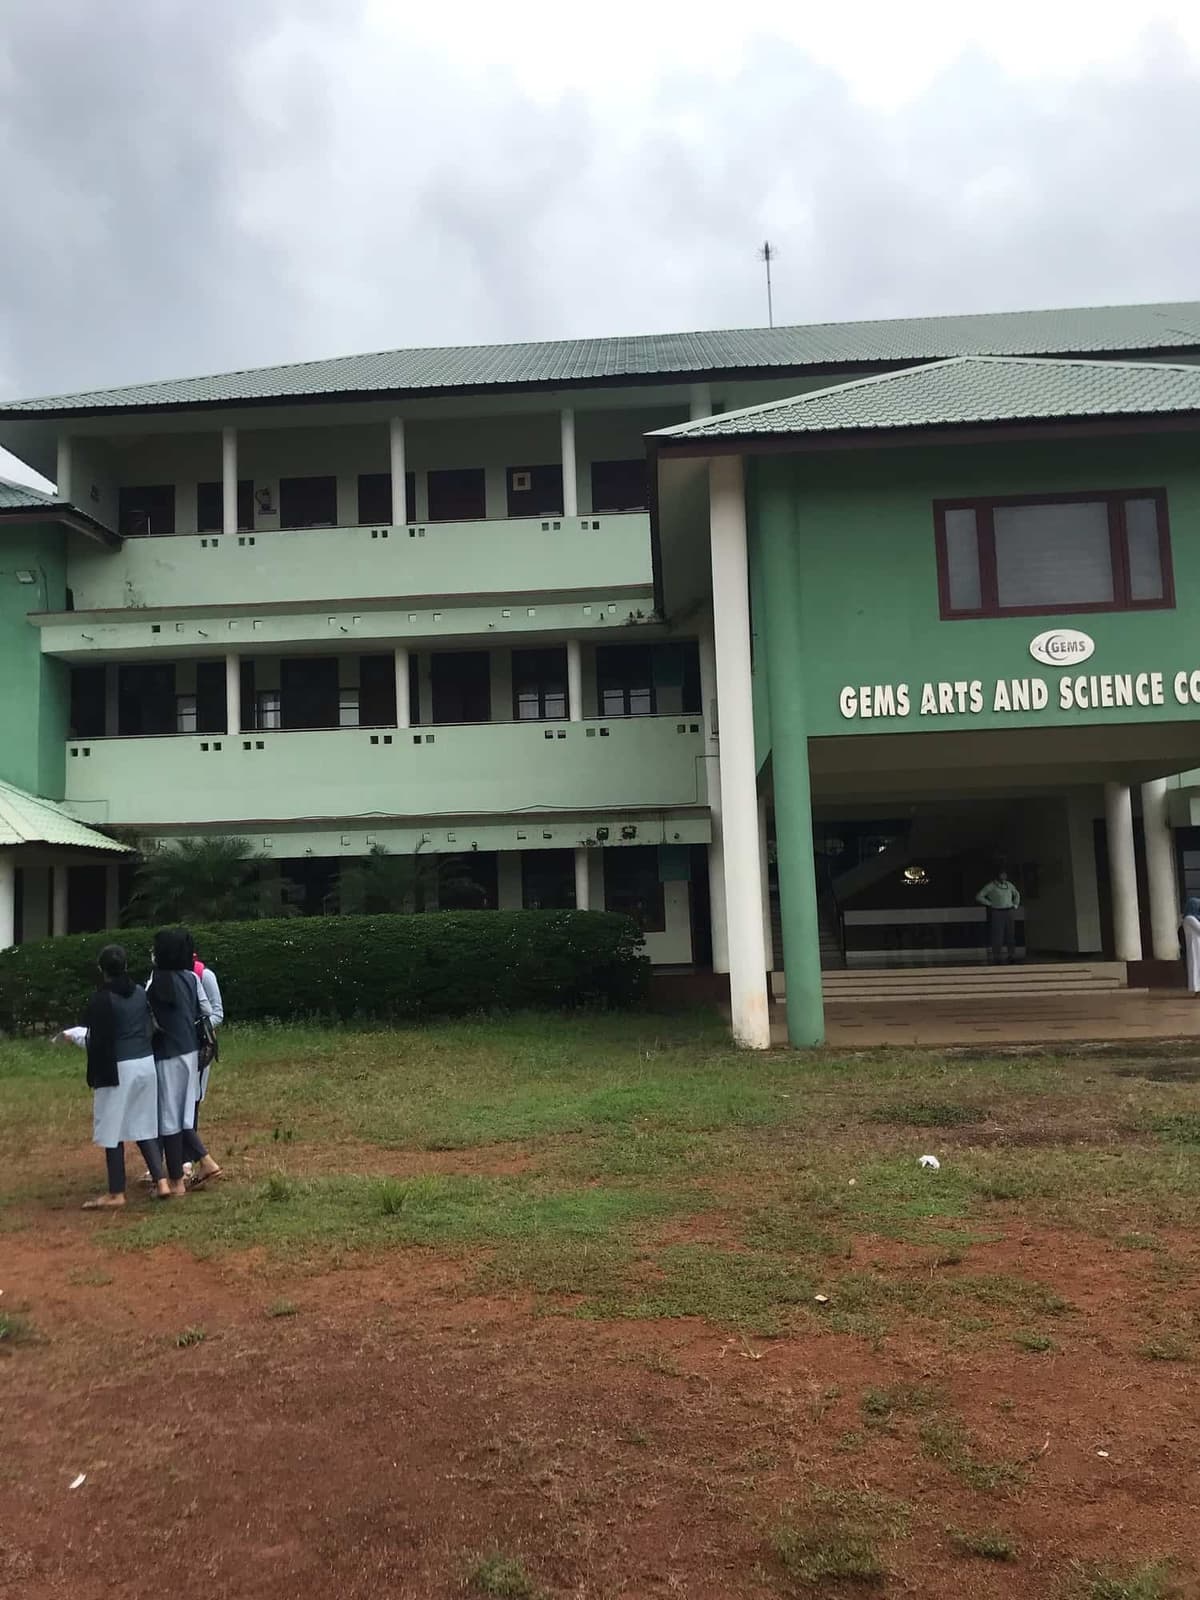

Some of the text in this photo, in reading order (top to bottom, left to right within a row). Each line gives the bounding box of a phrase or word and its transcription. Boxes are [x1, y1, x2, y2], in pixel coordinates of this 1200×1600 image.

[1051, 641, 1086, 653] GEMS
[839, 683, 911, 719] GEMS
[919, 680, 984, 715] ARTS
[993, 678, 1049, 712] AND
[1059, 672, 1165, 710] SCIENCE
